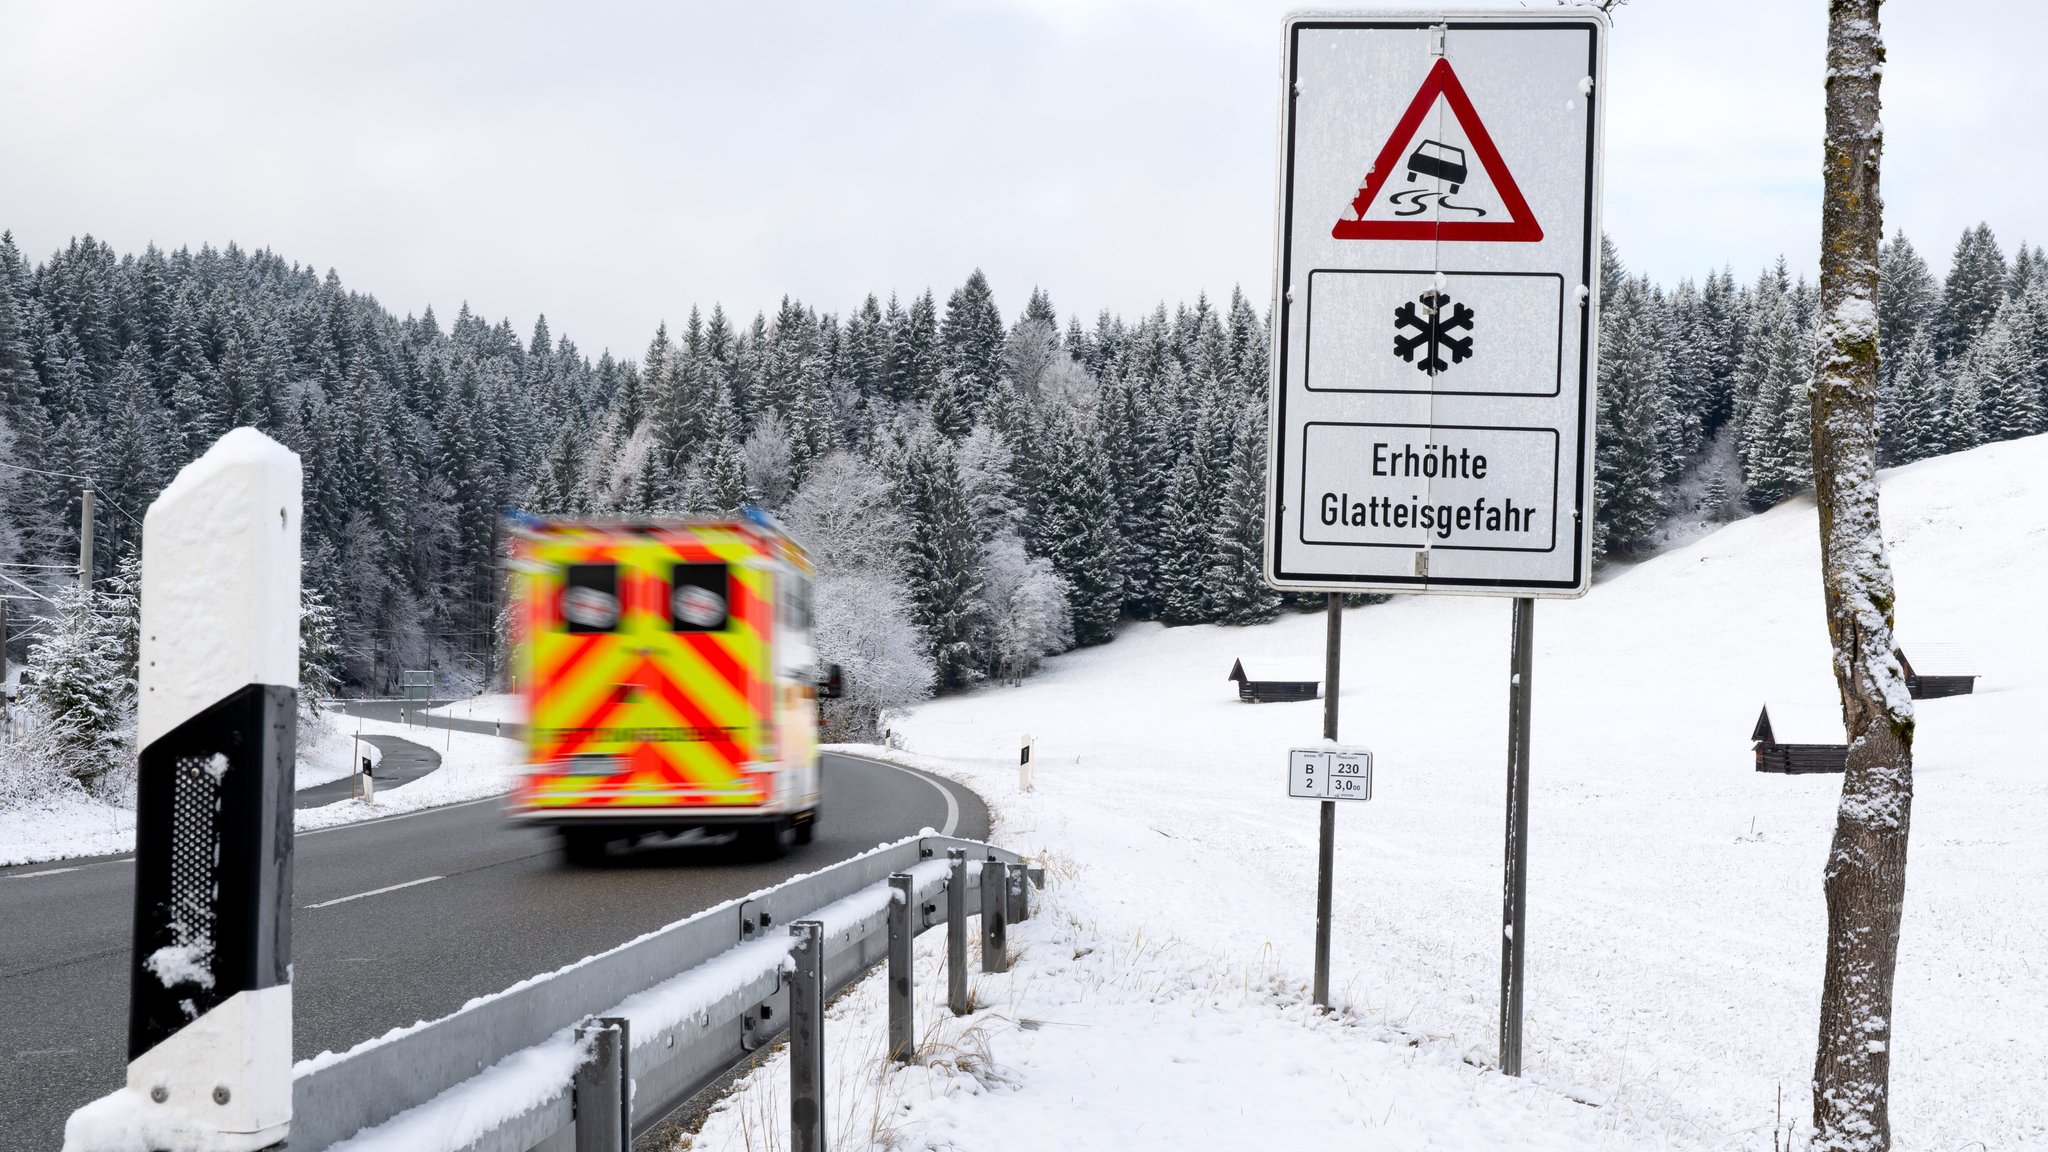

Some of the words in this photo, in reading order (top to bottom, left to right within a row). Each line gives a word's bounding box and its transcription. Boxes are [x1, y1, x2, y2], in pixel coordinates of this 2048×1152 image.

[1372, 443, 1487, 479] Erhöhte
[1320, 492, 1536, 538] Glatteisgefahr
[1305, 764, 1314, 774] B
[1337, 763, 1359, 775] 230
[1306, 778, 1313, 789] 2
